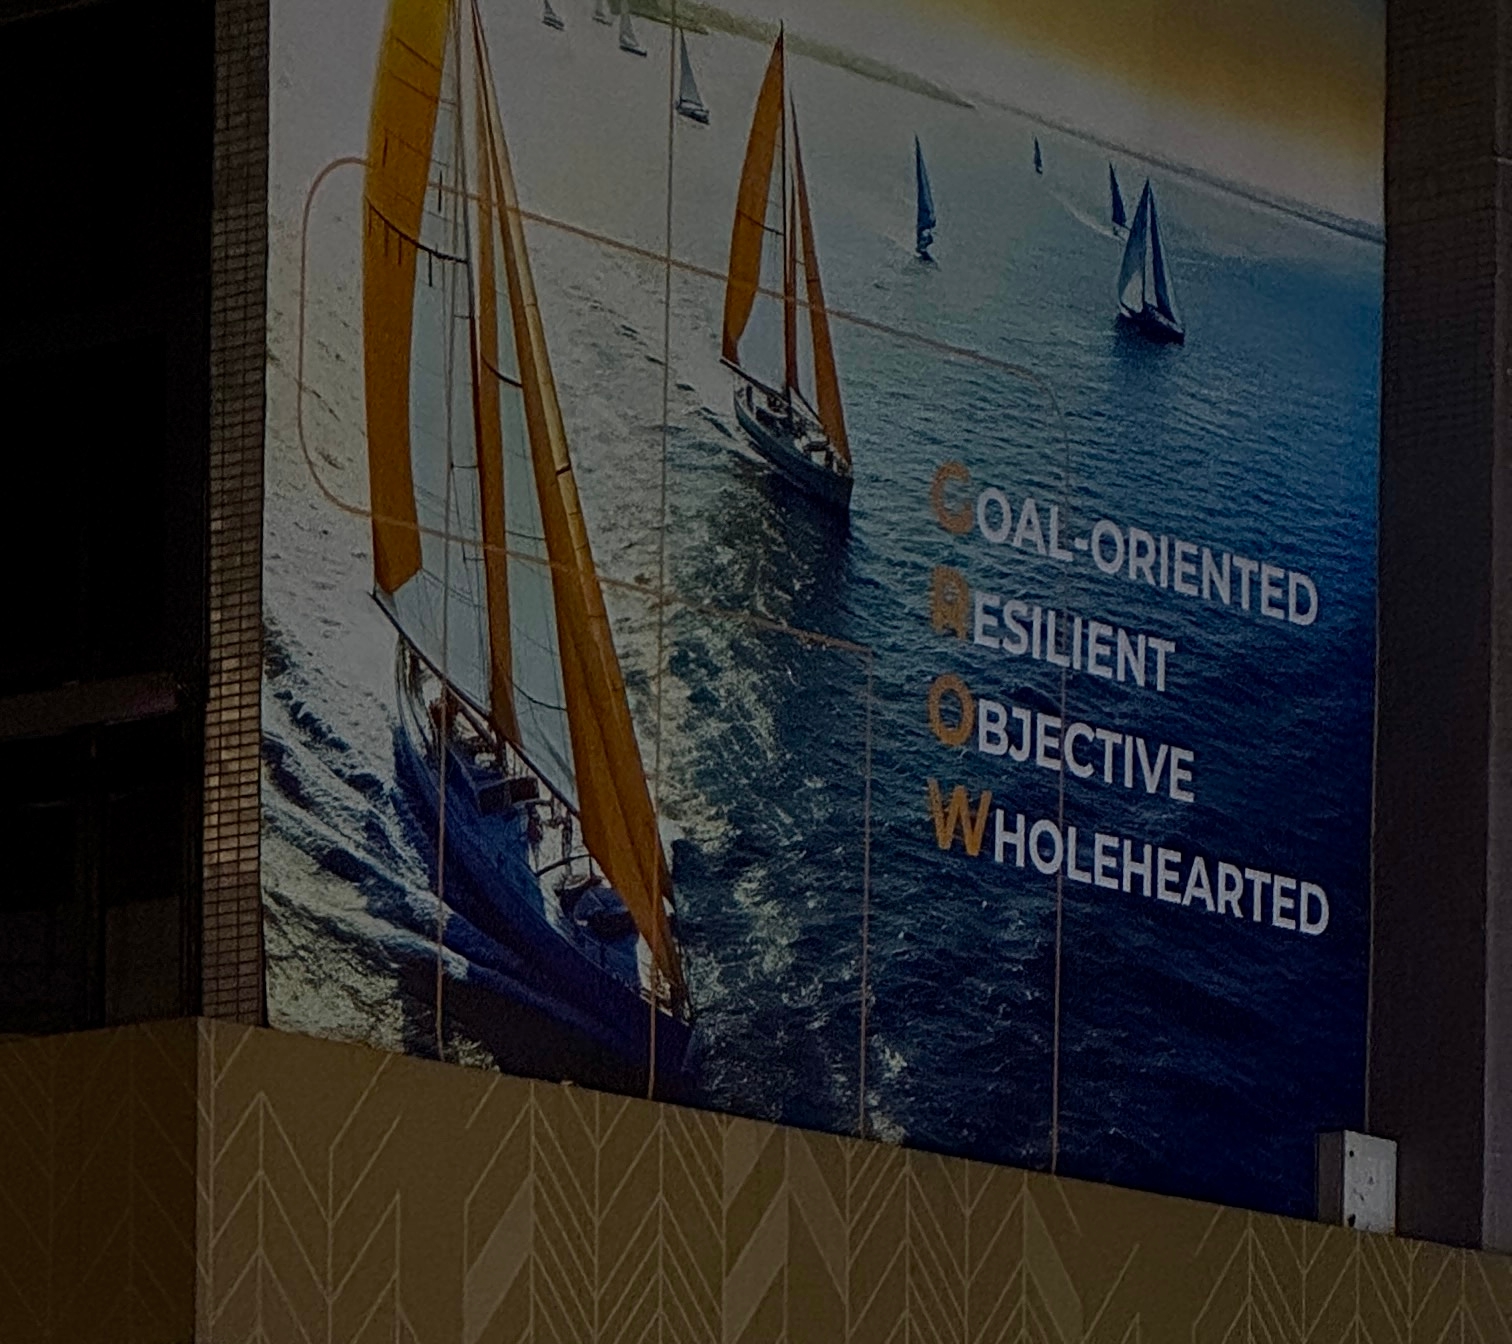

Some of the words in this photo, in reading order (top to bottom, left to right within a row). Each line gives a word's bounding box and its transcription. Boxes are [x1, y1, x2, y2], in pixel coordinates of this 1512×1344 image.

[928, 565, 1176, 693] RESILIENT
[927, 673, 1195, 803] OBJECTIVE
[927, 777, 1330, 936] WHOLEHEARTED
